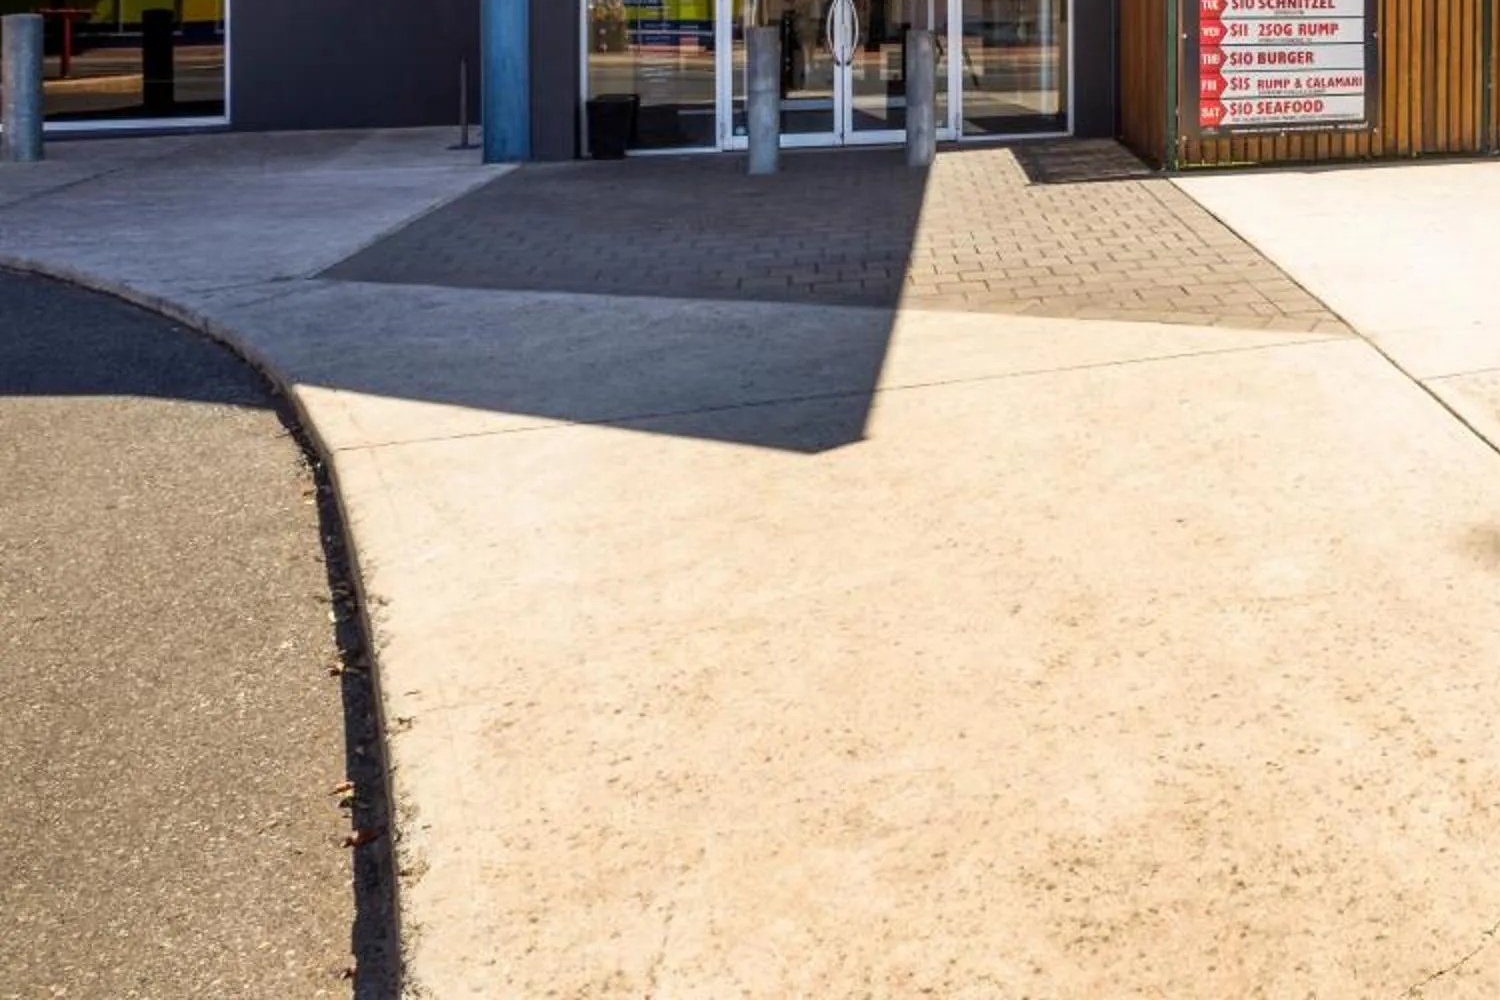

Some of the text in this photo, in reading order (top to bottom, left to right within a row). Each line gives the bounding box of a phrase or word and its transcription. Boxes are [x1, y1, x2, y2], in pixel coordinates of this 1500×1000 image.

[1257, 23, 1293, 37] 250G
[1298, 22, 1340, 36] RUMP
[1229, 51, 1315, 66] $10 BURGER
[1257, 78, 1291, 89] RUMP
[1306, 76, 1363, 89] CALAMARI
[1229, 99, 1325, 117] $10 SEAFOOD
